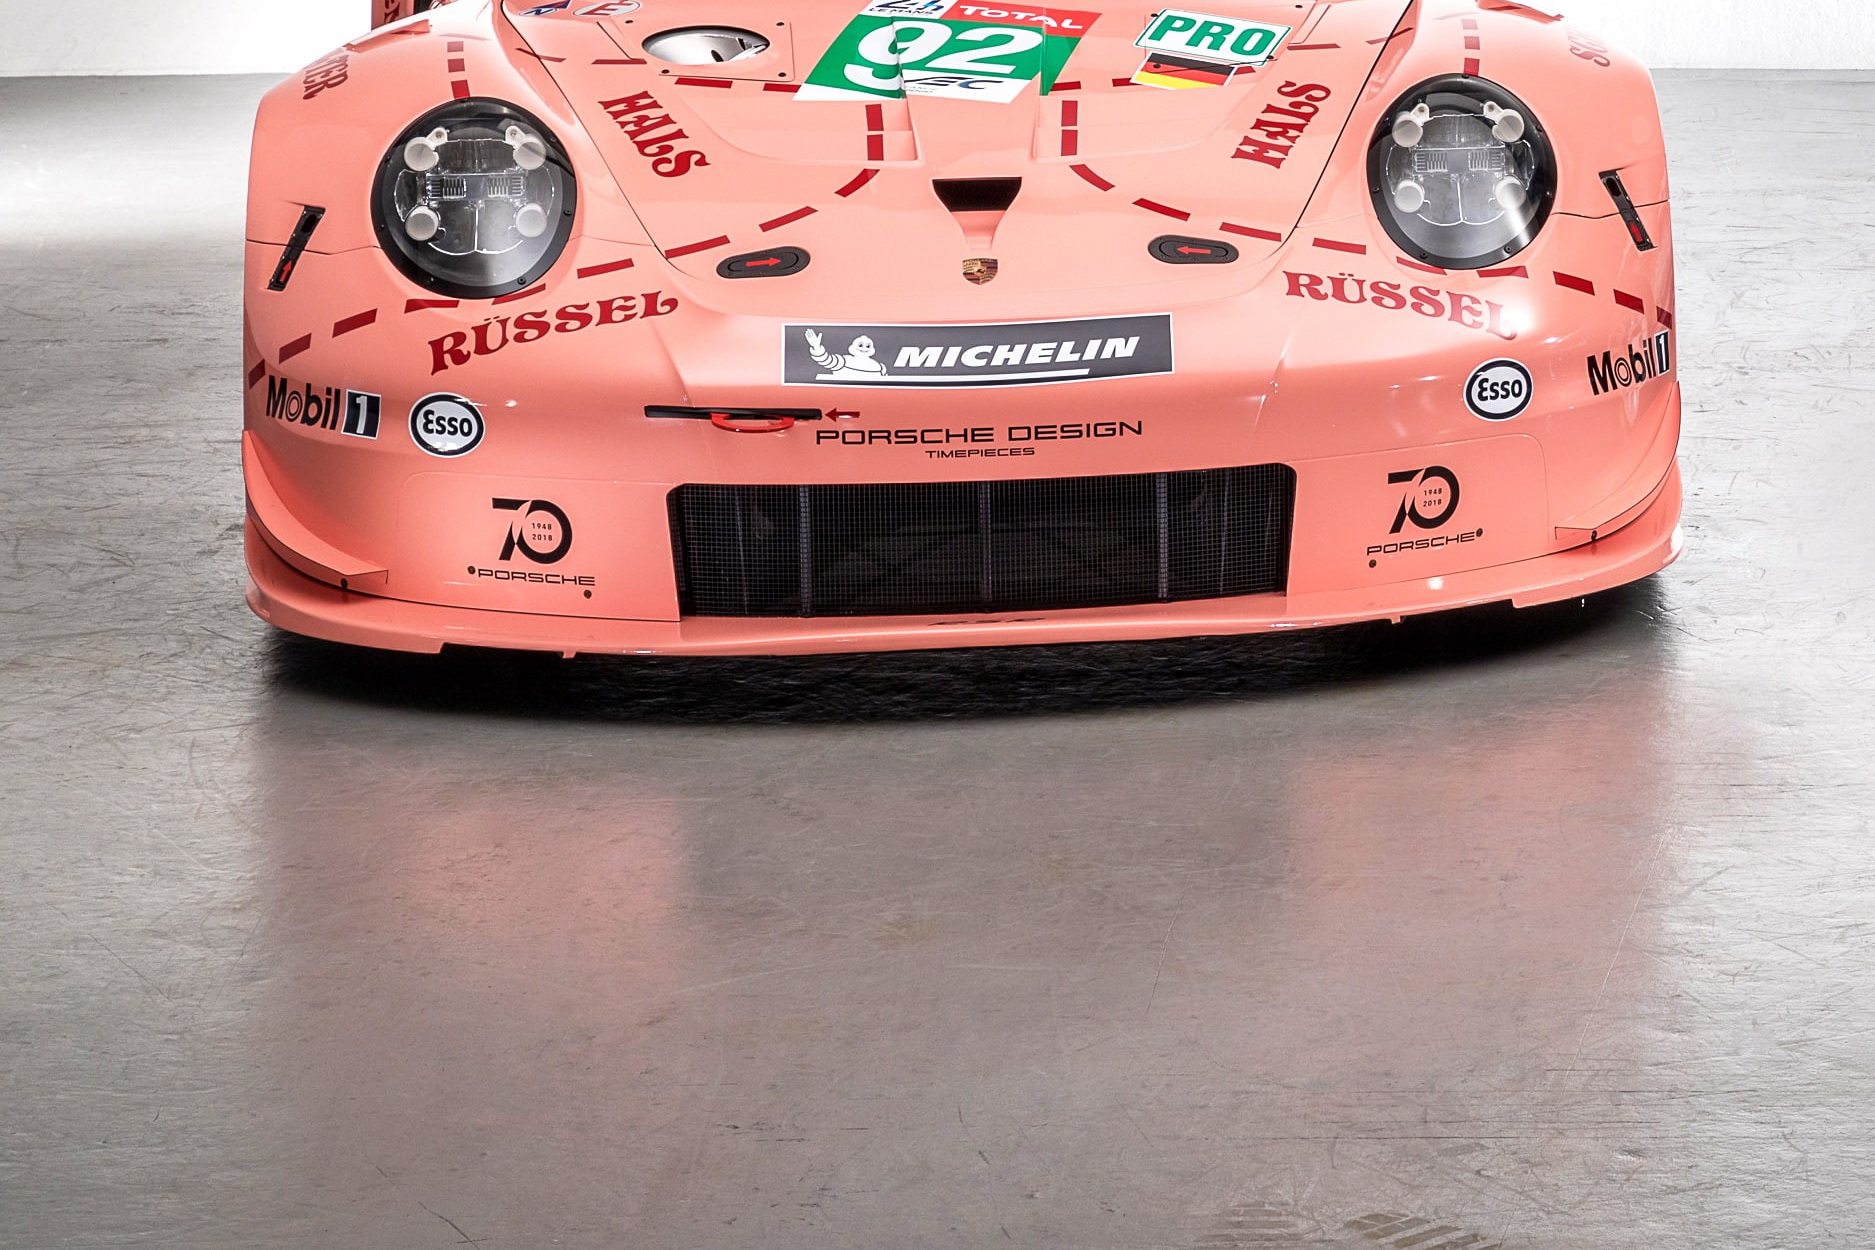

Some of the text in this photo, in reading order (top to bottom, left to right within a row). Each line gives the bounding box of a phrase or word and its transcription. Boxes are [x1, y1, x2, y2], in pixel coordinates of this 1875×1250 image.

[960, 5, 1084, 30] TOTAL
[1148, 15, 1278, 55] PRO
[844, 20, 1044, 91] 92
[598, 90, 710, 178] HALS
[1231, 81, 1331, 169] HALS
[1282, 270, 1518, 341] RÜSSEL
[428, 290, 679, 376] RÜSSEL
[893, 335, 1141, 368] MICHELIN
[1587, 337, 1656, 396] Mobil
[266, 374, 341, 431] Mobil
[1477, 377, 1523, 402] Esso
[422, 409, 473, 438] Esso
[816, 421, 1143, 446] PORSCHE DESIGN
[925, 447, 1036, 459] TIMEPIECES
[1387, 465, 1460, 534] 70
[1422, 498, 1443, 507] 2018
[1423, 488, 1443, 497] 1948
[492, 497, 573, 565] 70
[531, 522, 553, 531] 1948
[531, 533, 553, 542] 2018
[1366, 531, 1476, 556] PORSCHE
[478, 568, 596, 586] PORSCHE
